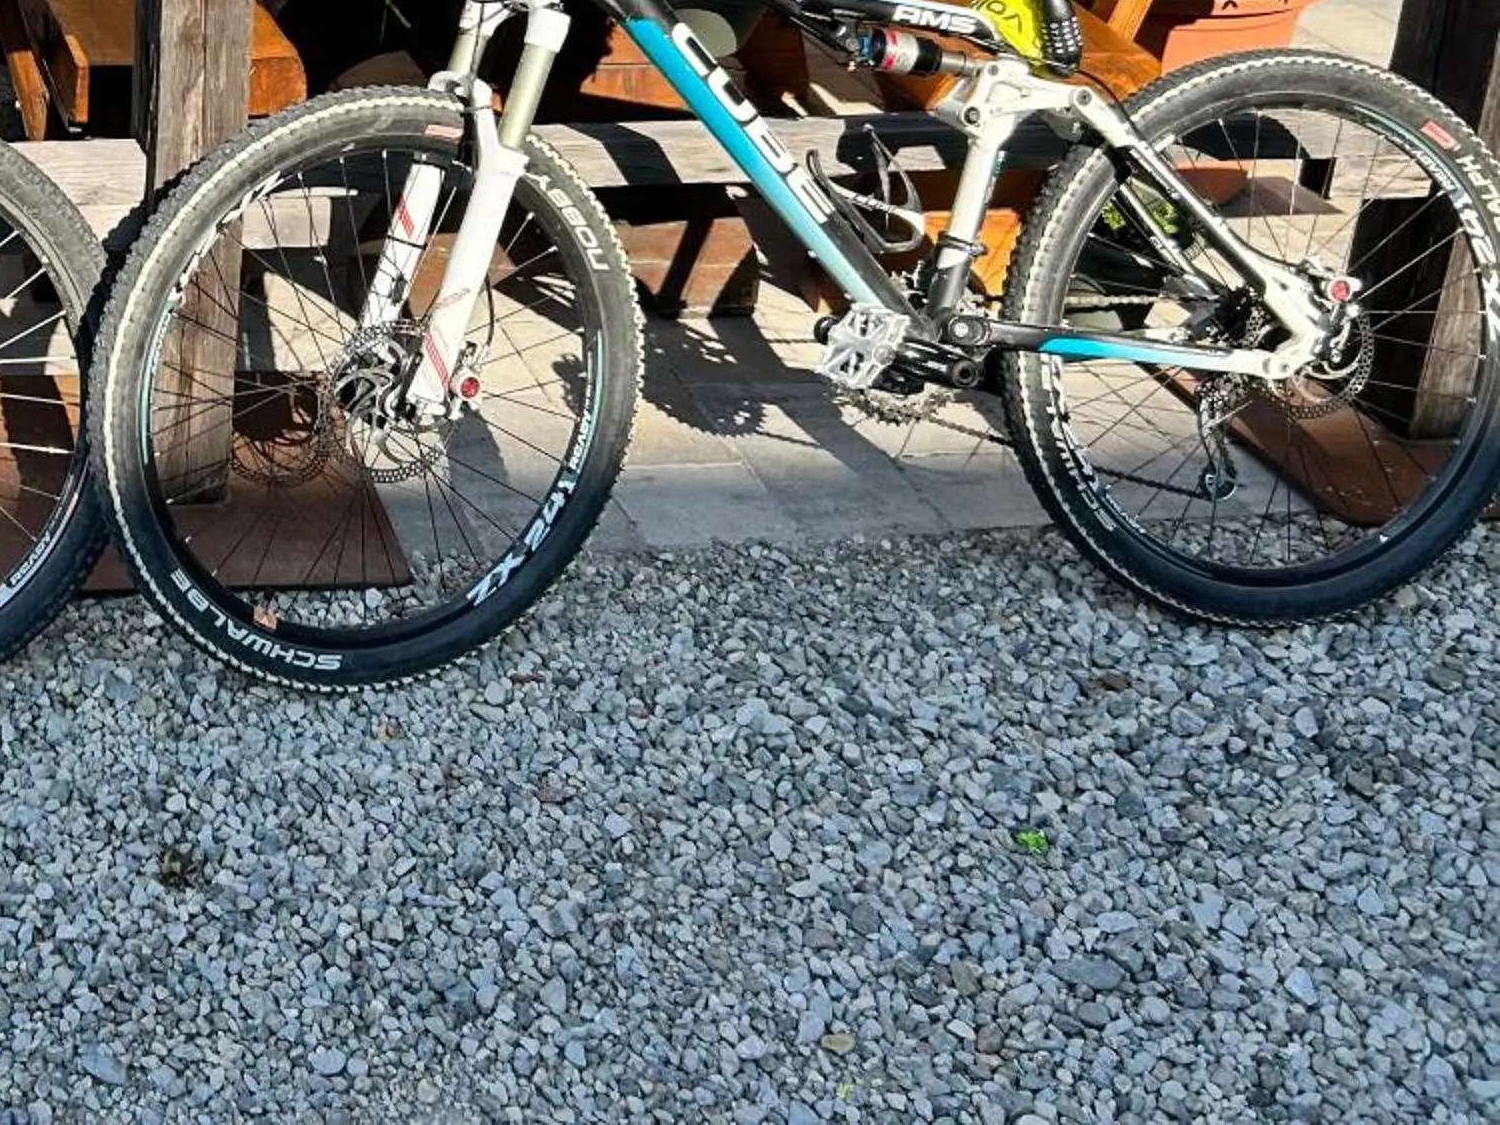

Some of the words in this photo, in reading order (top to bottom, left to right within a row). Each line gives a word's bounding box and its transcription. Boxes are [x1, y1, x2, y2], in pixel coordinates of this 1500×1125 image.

[892, 4, 979, 36] AMS
[671, 21, 837, 224] CUBE
[532, 173, 608, 272] NOBBY
[169, 568, 344, 671] SCHWALBE
